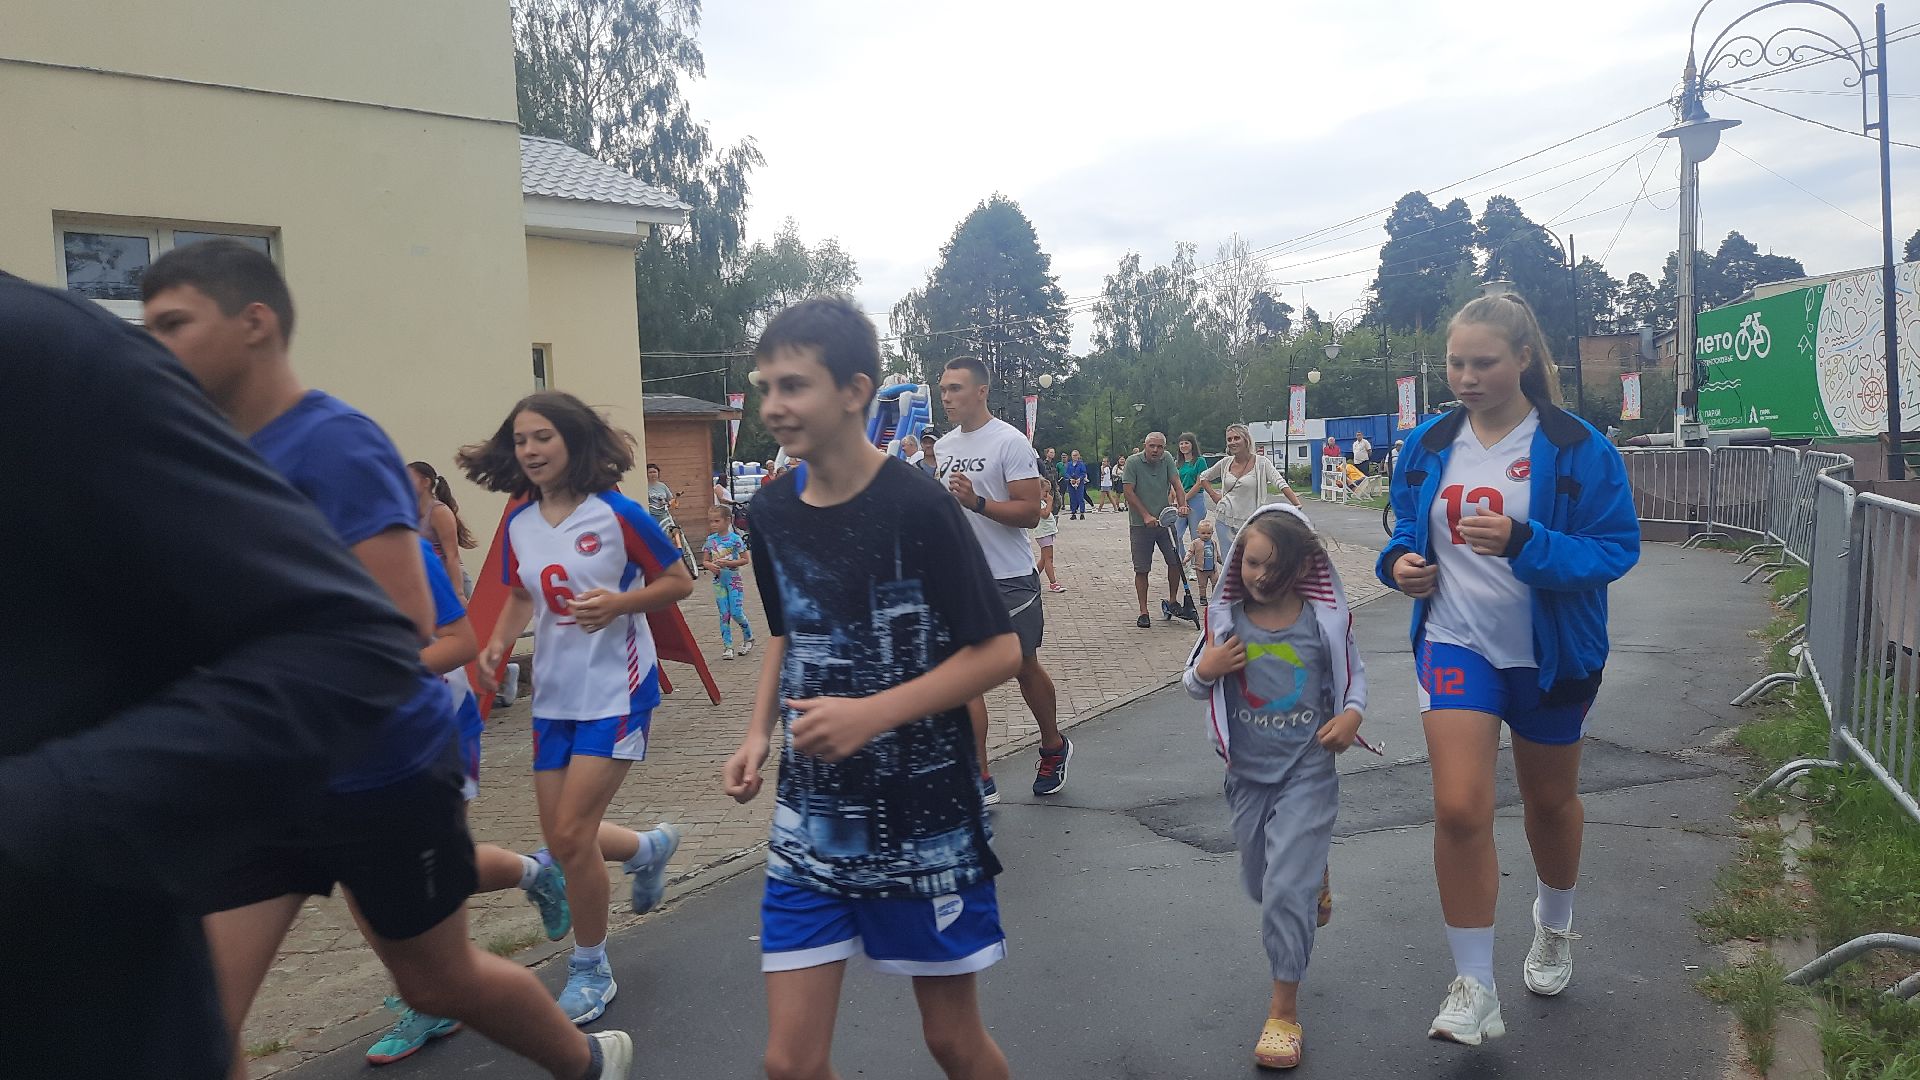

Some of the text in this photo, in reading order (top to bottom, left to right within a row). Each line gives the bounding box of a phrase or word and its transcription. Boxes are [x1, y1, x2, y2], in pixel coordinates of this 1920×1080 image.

[1696, 331, 1733, 354] лето
[540, 563, 576, 616] 6
[1432, 667, 1466, 695] 12
